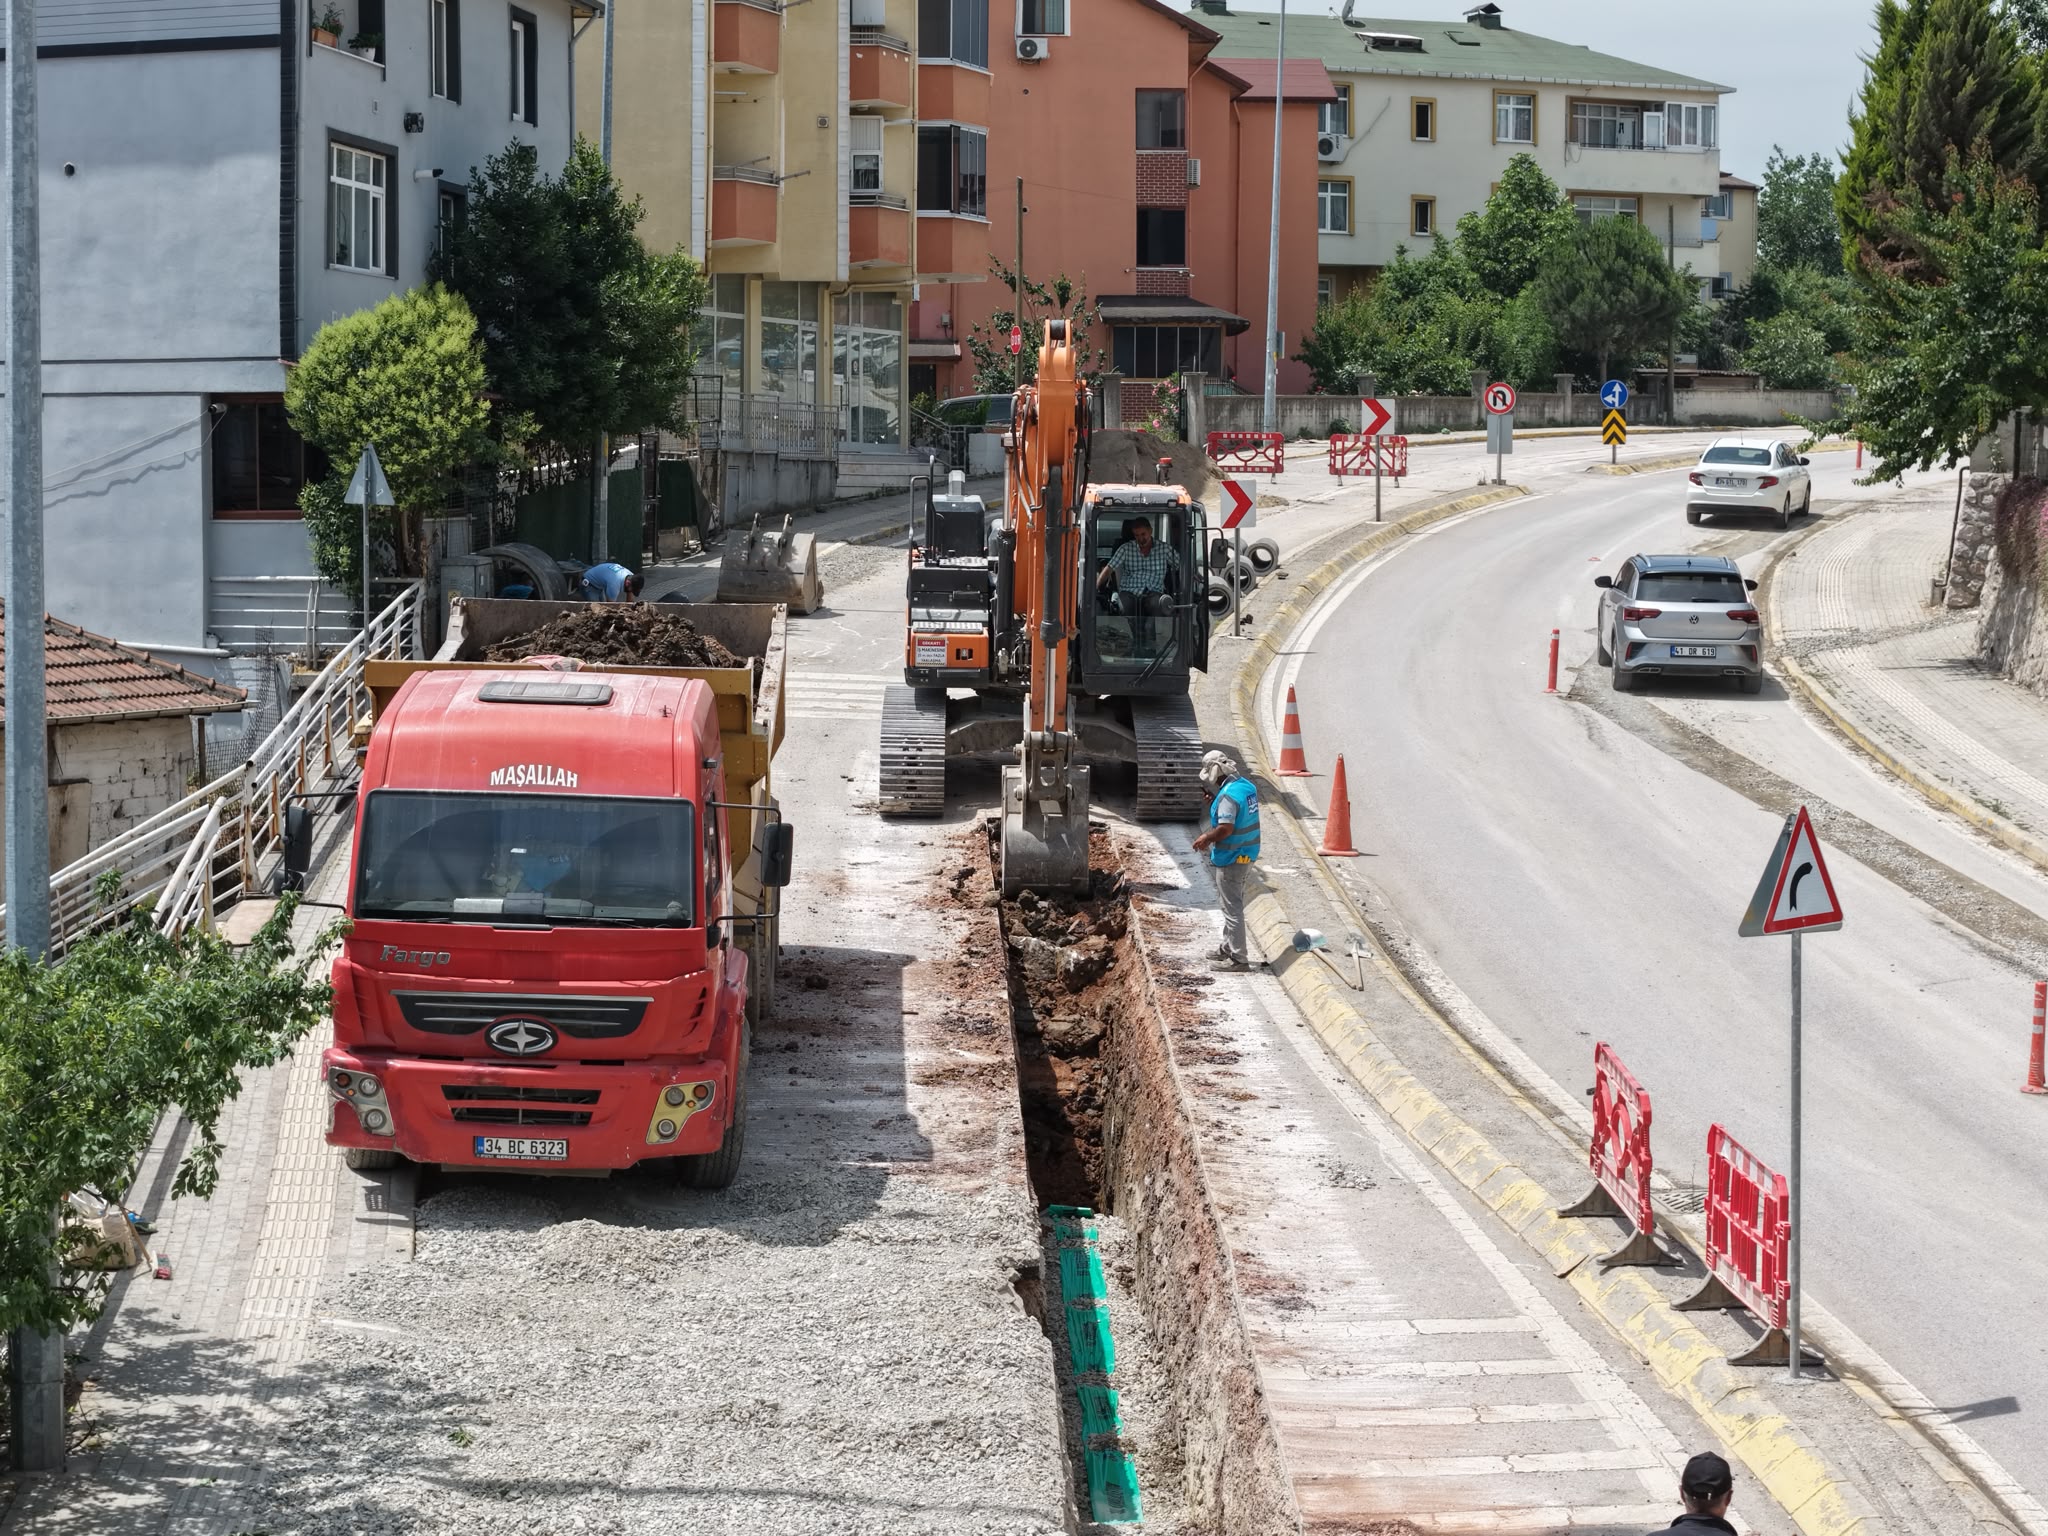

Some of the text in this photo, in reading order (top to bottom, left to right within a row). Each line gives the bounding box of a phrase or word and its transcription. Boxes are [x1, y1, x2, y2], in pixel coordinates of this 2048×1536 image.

[1702, 648, 1715, 656] 619
[490, 764, 578, 788] MAŞALLAH
[380, 945, 451, 968] Fargo
[486, 1139, 502, 1153] 34
[508, 1140, 525, 1154] BC
[530, 1141, 564, 1155] 6323
